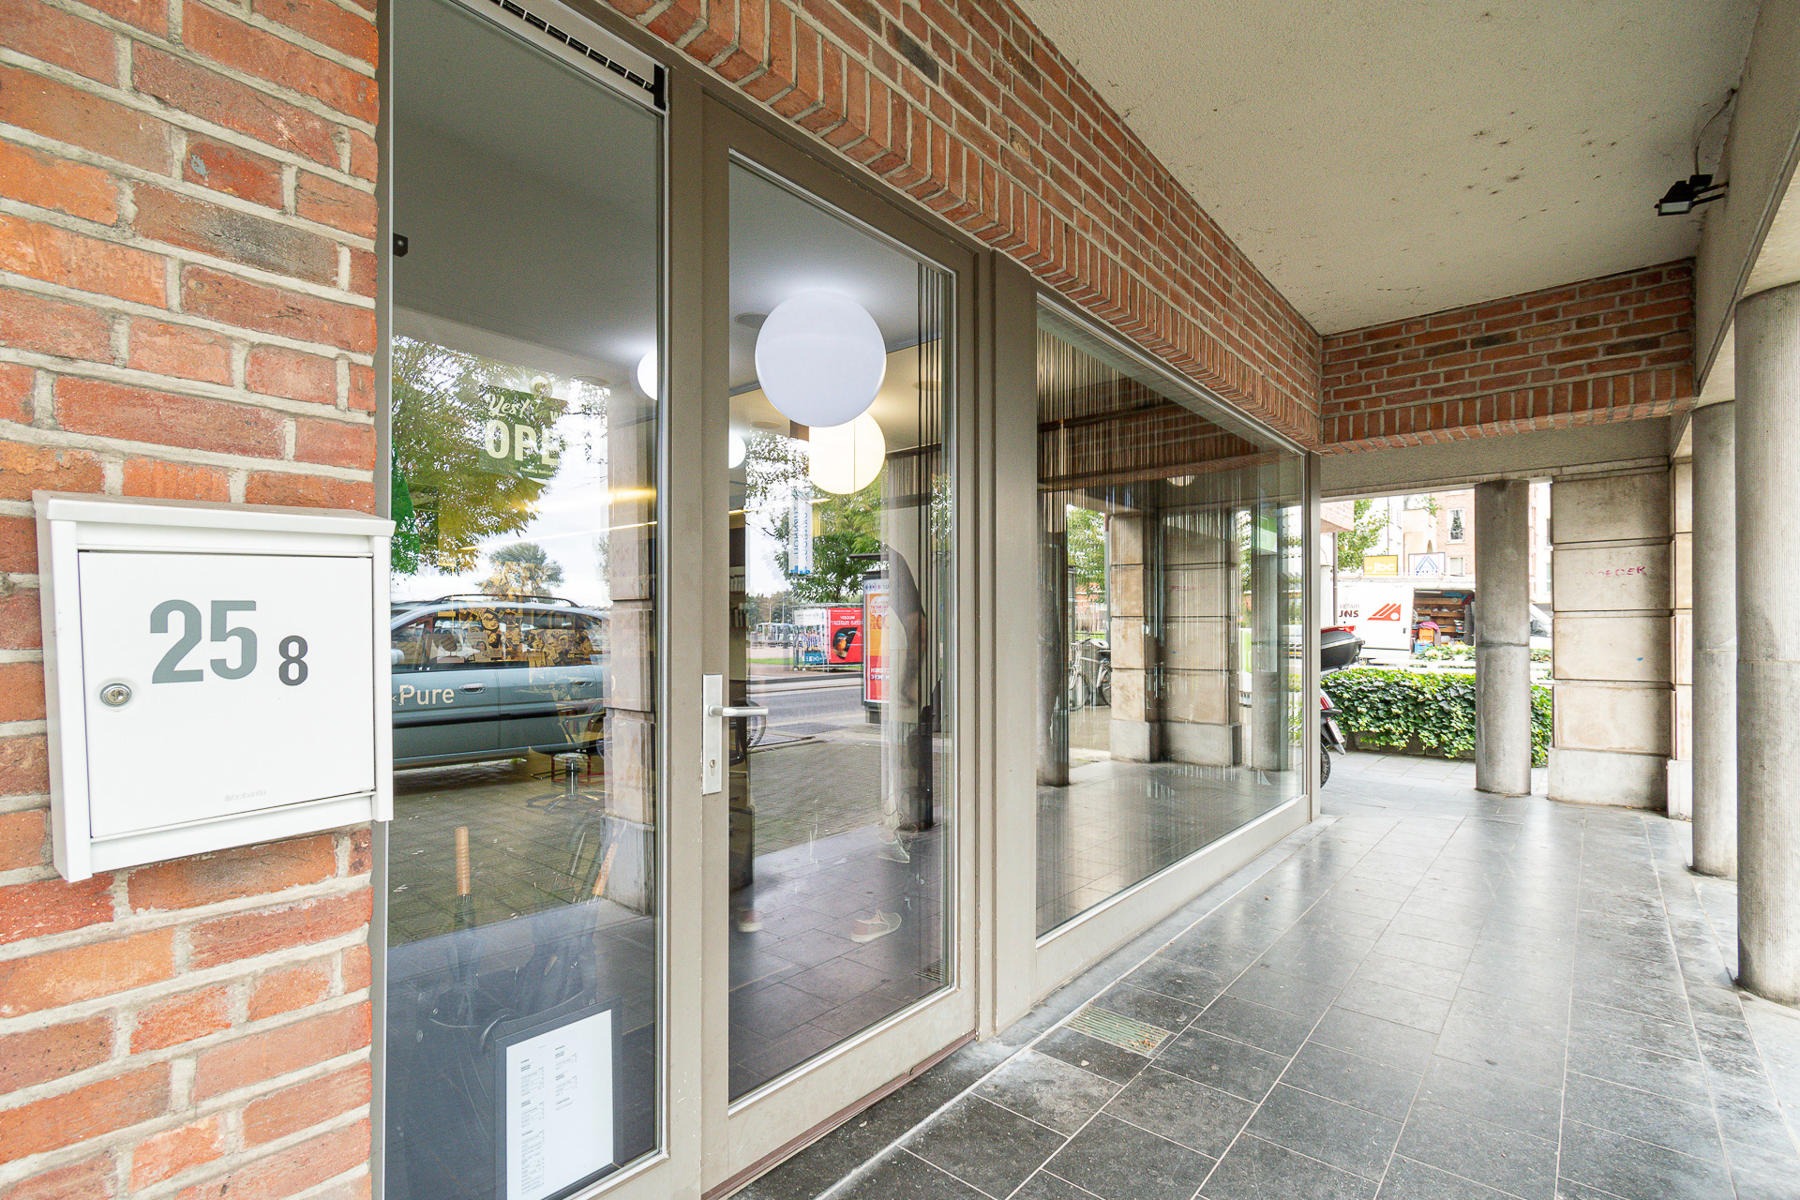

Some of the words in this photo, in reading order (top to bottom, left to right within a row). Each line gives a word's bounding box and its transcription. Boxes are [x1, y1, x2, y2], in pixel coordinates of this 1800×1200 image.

[485, 419, 560, 466] OPE
[150, 599, 257, 684] 25
[278, 635, 308, 686] 8
[399, 684, 455, 706] Pure
